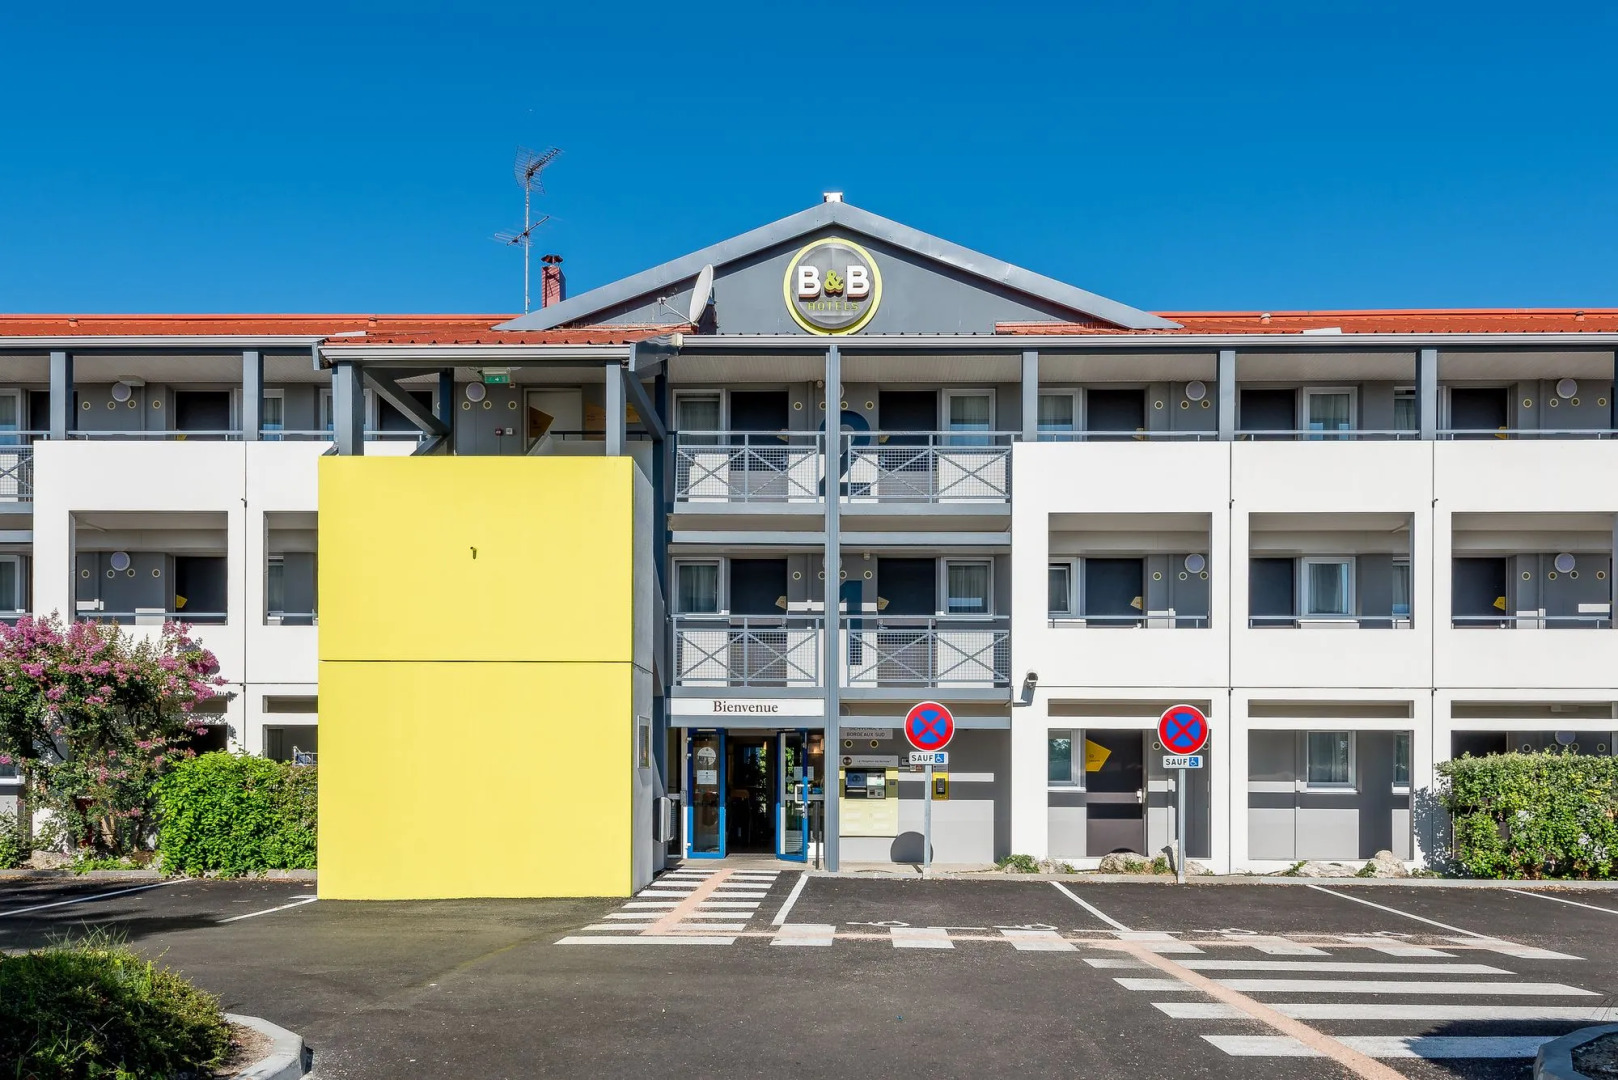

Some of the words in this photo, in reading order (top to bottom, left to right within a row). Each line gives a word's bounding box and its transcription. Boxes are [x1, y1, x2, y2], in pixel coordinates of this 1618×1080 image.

[798, 265, 870, 298] B&B
[807, 300, 859, 311] HOTELS
[818, 410, 871, 496] 2
[712, 700, 779, 713] Bienvenue
[911, 754, 934, 762] SAUF
[1165, 758, 1188, 766] SAUF
